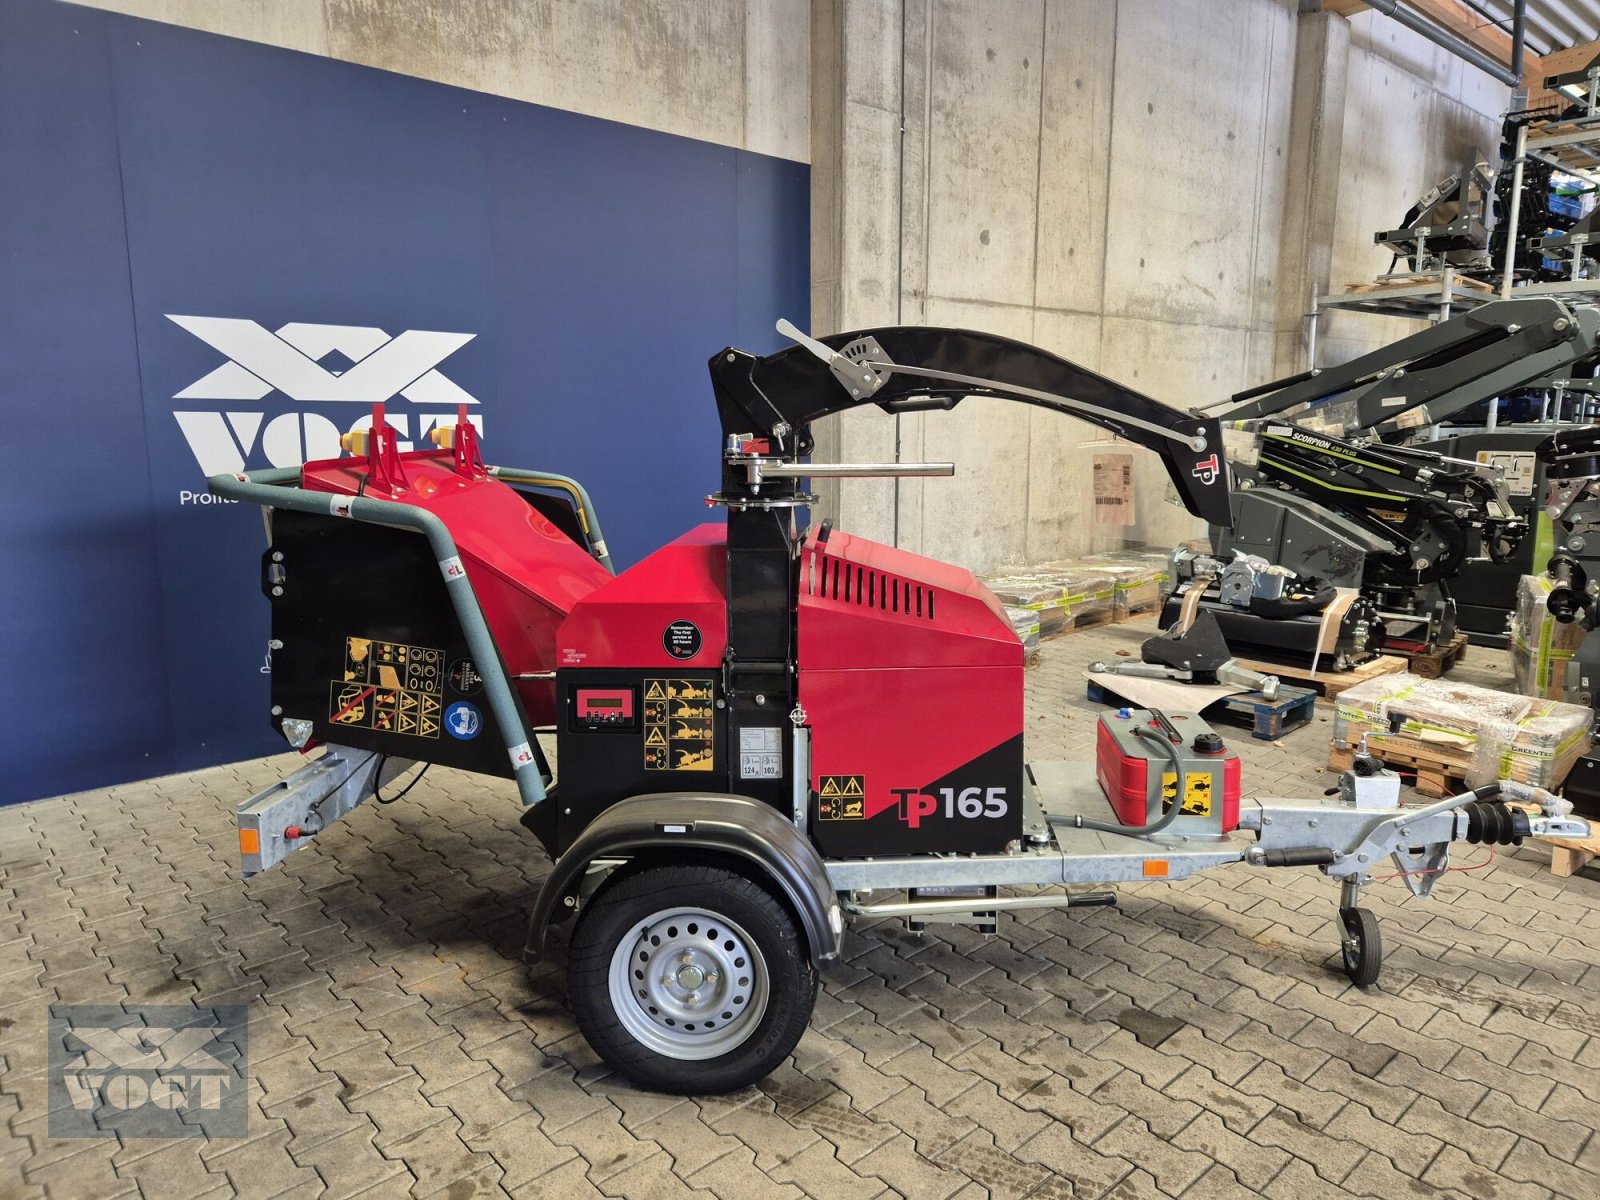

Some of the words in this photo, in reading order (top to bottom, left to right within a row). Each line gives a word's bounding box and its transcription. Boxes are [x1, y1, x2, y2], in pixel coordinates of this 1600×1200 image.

[1292, 432, 1331, 450] SCORPION
[1342, 448, 1358, 458] PLUS
[744, 766, 755, 774] 124
[889, 787, 938, 829] TP
[939, 786, 1008, 819] 165
